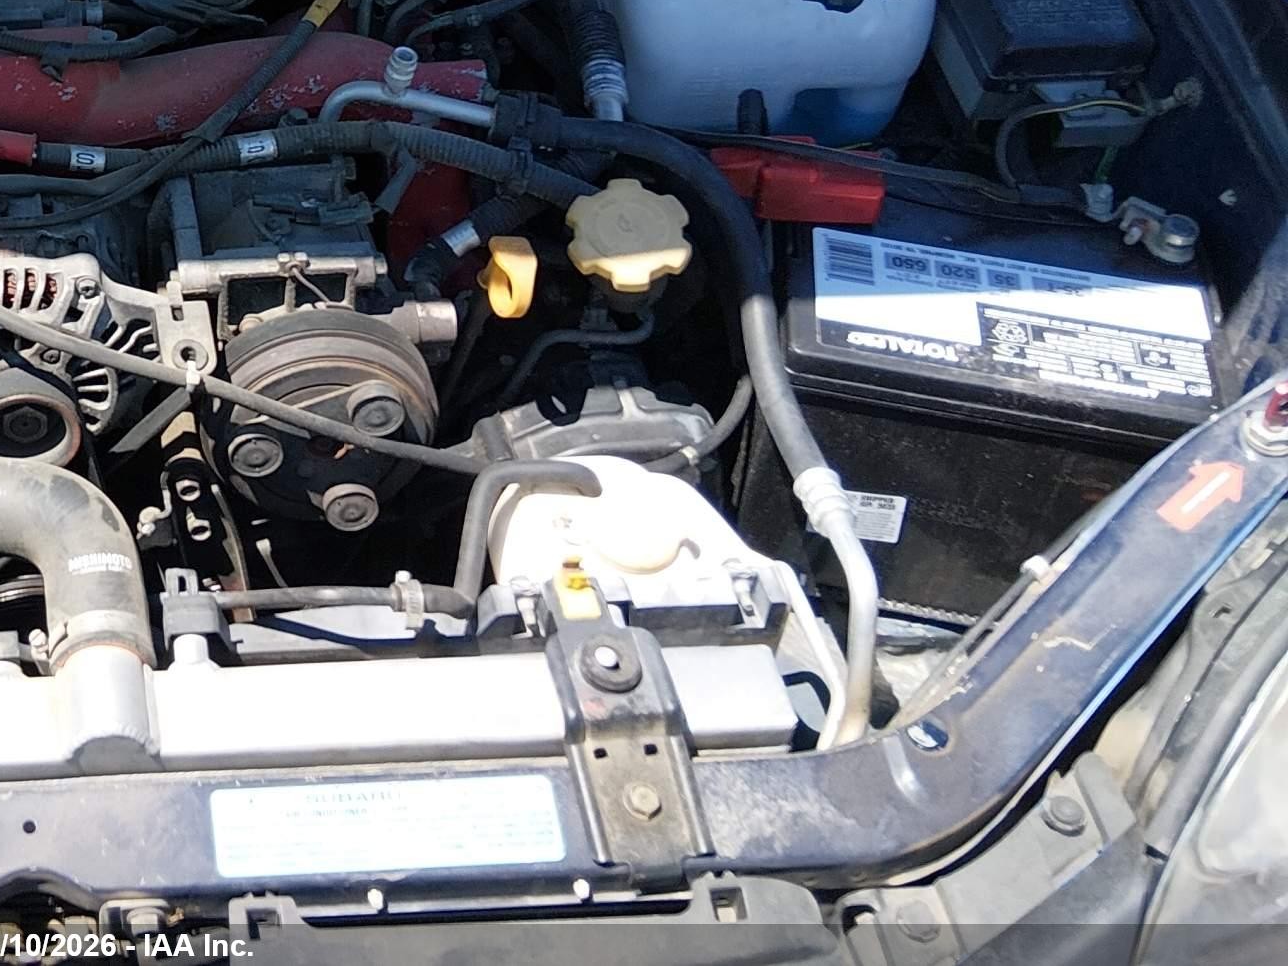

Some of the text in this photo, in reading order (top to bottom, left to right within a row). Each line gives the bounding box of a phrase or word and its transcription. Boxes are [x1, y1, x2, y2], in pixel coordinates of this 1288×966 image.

[892, 256, 927, 272] 650
[941, 263, 977, 279] 520
[994, 272, 1016, 286] 35
